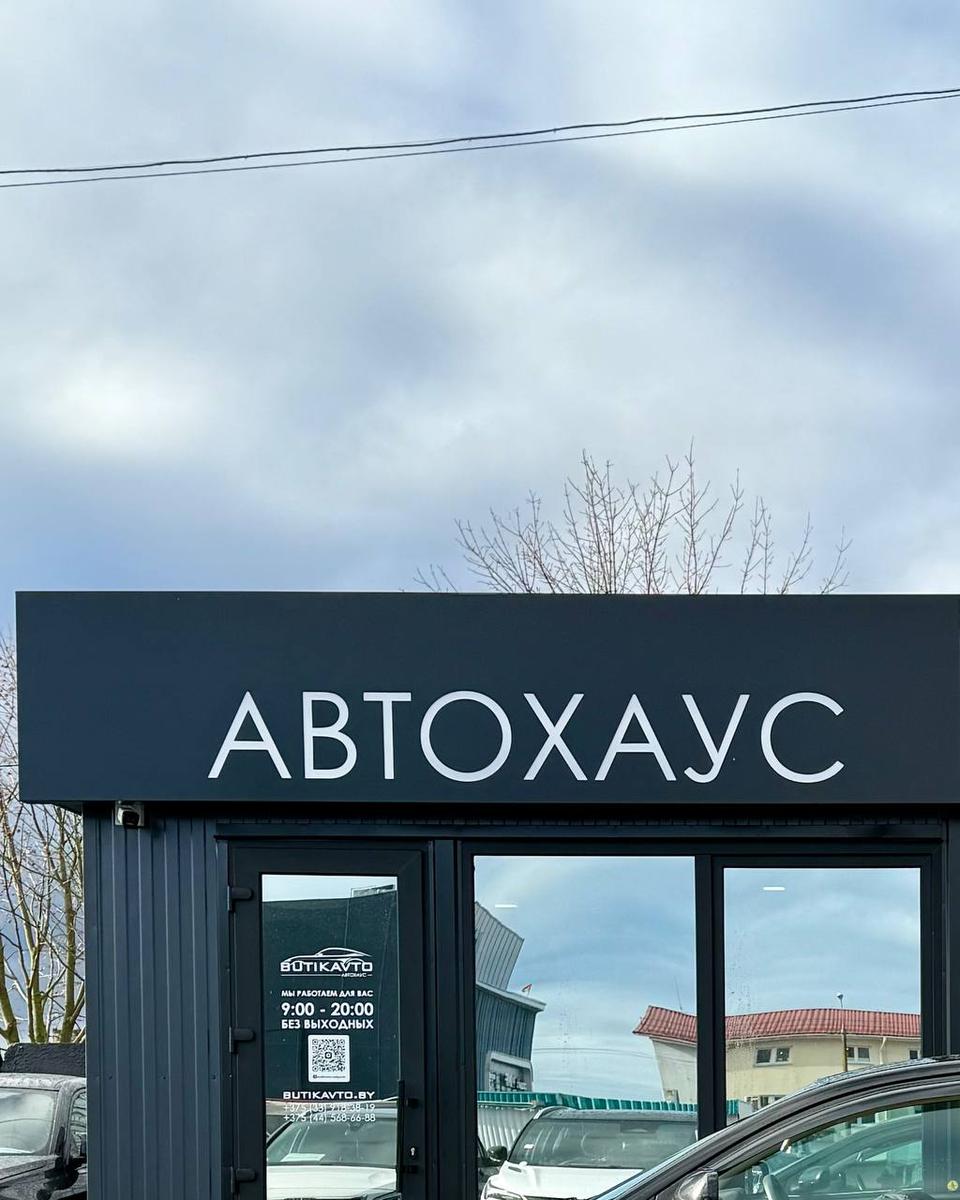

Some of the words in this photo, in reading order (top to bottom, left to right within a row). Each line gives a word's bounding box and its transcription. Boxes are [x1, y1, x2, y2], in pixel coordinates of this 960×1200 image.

[207, 690, 845, 783] АВТОХАУС
[280, 961, 373, 972] BUTIKAVTO
[339, 990, 355, 998] ДЛЯ
[281, 1003, 315, 1016] 9:00
[330, 1003, 374, 1016] 20:00
[281, 1019, 300, 1030] БЕЗ
[304, 1019, 374, 1030] ВЫХОДНЫХ
[283, 1091, 375, 1100] BUTIKAVTO.BY
[283, 1113, 306, 1122] +375
[309, 1113, 327, 1123] (44)
[330, 1113, 376, 1122] 568-66-88
